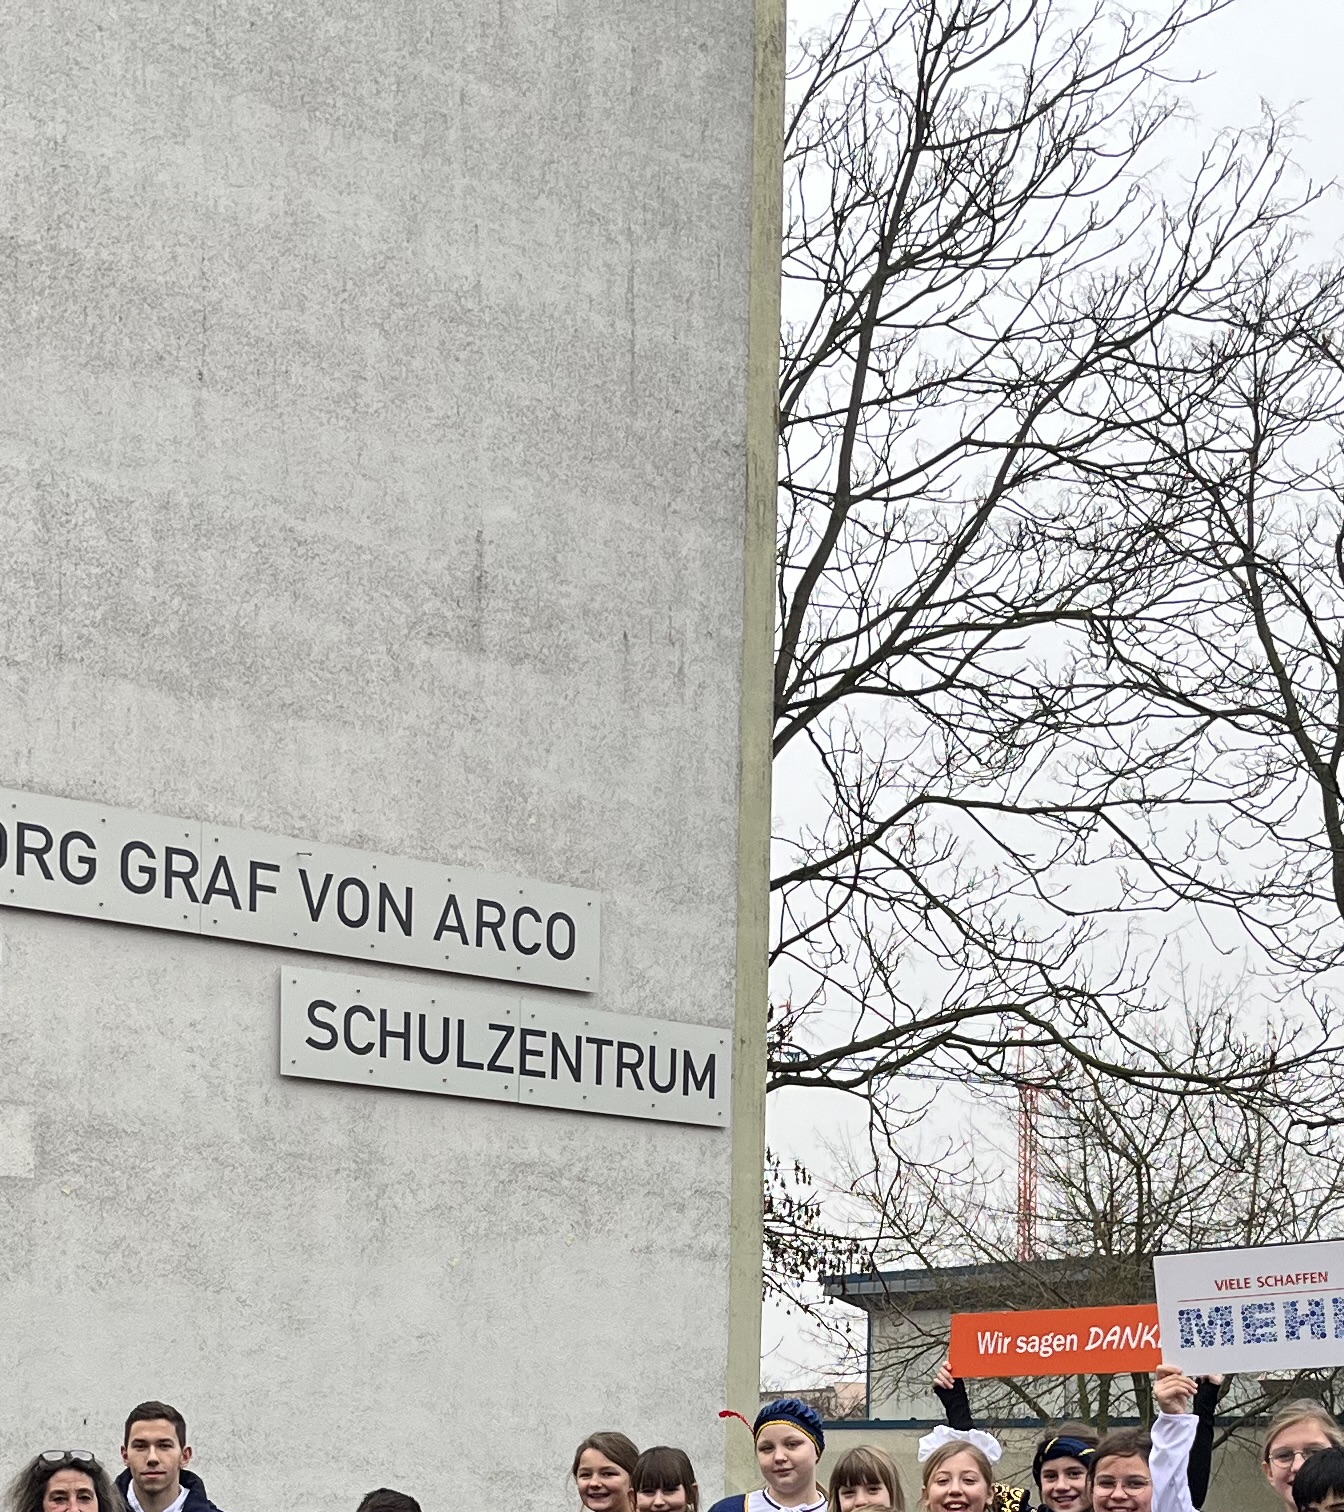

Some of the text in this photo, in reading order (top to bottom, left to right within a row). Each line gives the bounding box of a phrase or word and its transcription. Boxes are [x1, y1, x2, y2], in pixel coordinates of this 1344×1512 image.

[120, 840, 281, 914] GRAF
[297, 867, 415, 938] VON
[432, 892, 578, 962] ARCO
[304, 999, 719, 1100] SCHULZENTRUM
[1214, 1270, 1330, 1292] VIELE SCHAFFEN
[977, 1321, 1163, 1357] Wir sagen DANK
